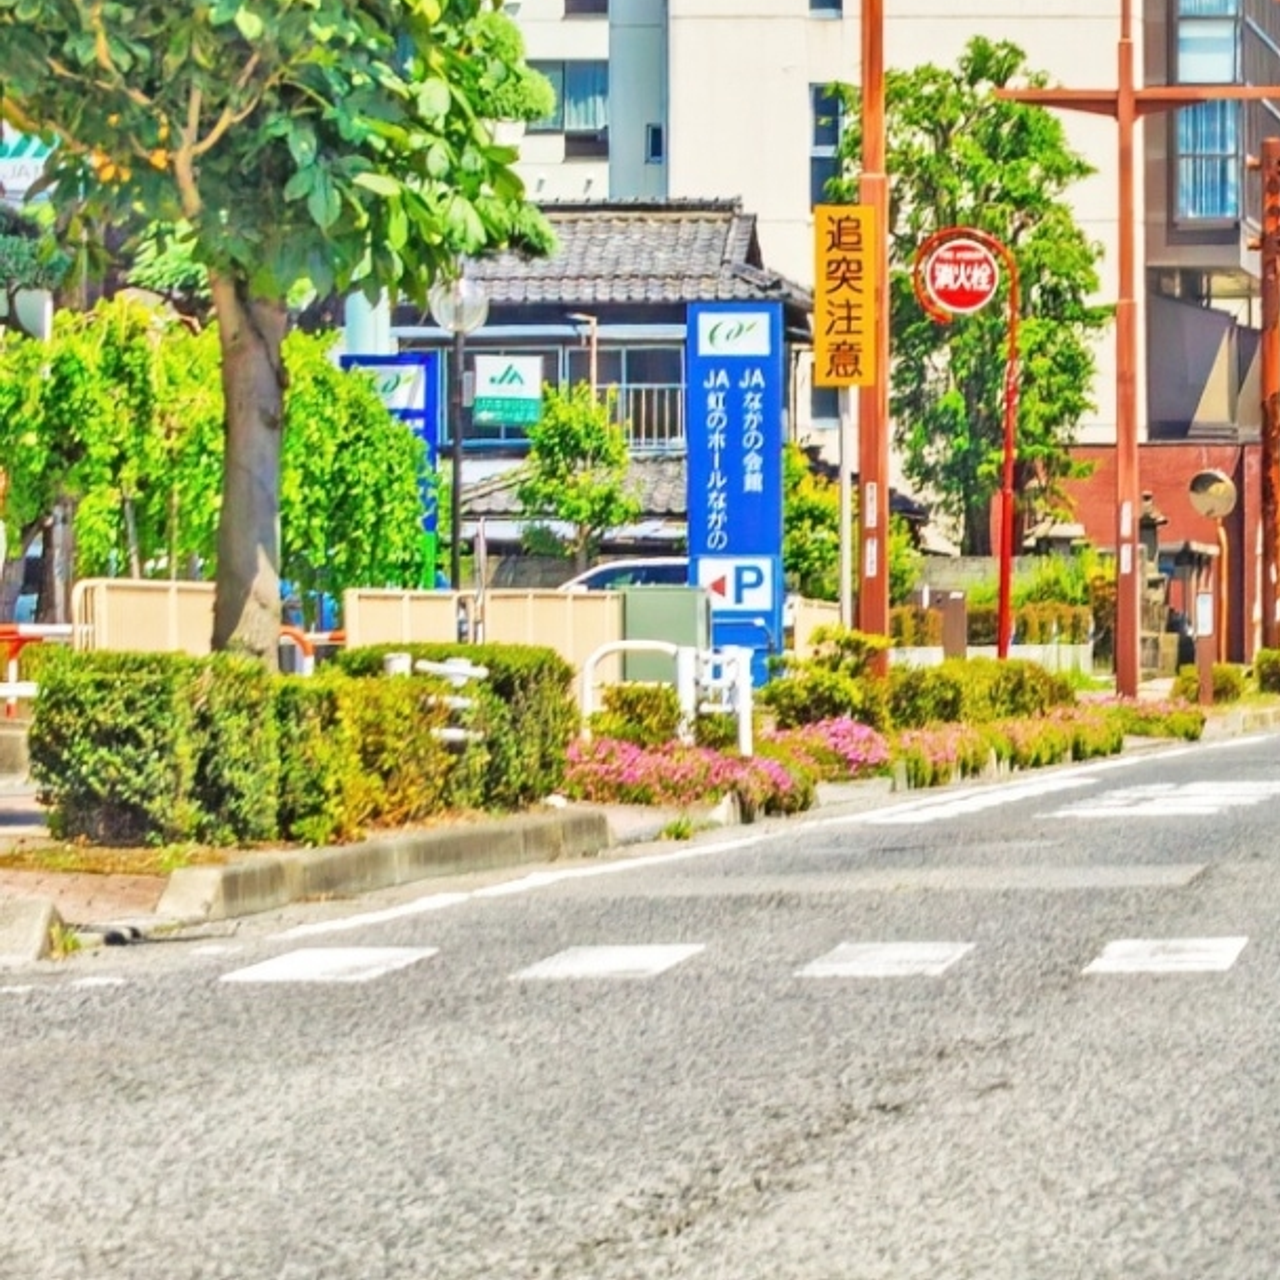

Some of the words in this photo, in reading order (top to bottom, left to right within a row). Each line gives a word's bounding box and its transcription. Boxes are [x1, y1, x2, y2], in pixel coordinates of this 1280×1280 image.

[825, 215, 863, 378] 追突注意
[933, 262, 992, 292] 消火栓
[734, 564, 765, 605] P
